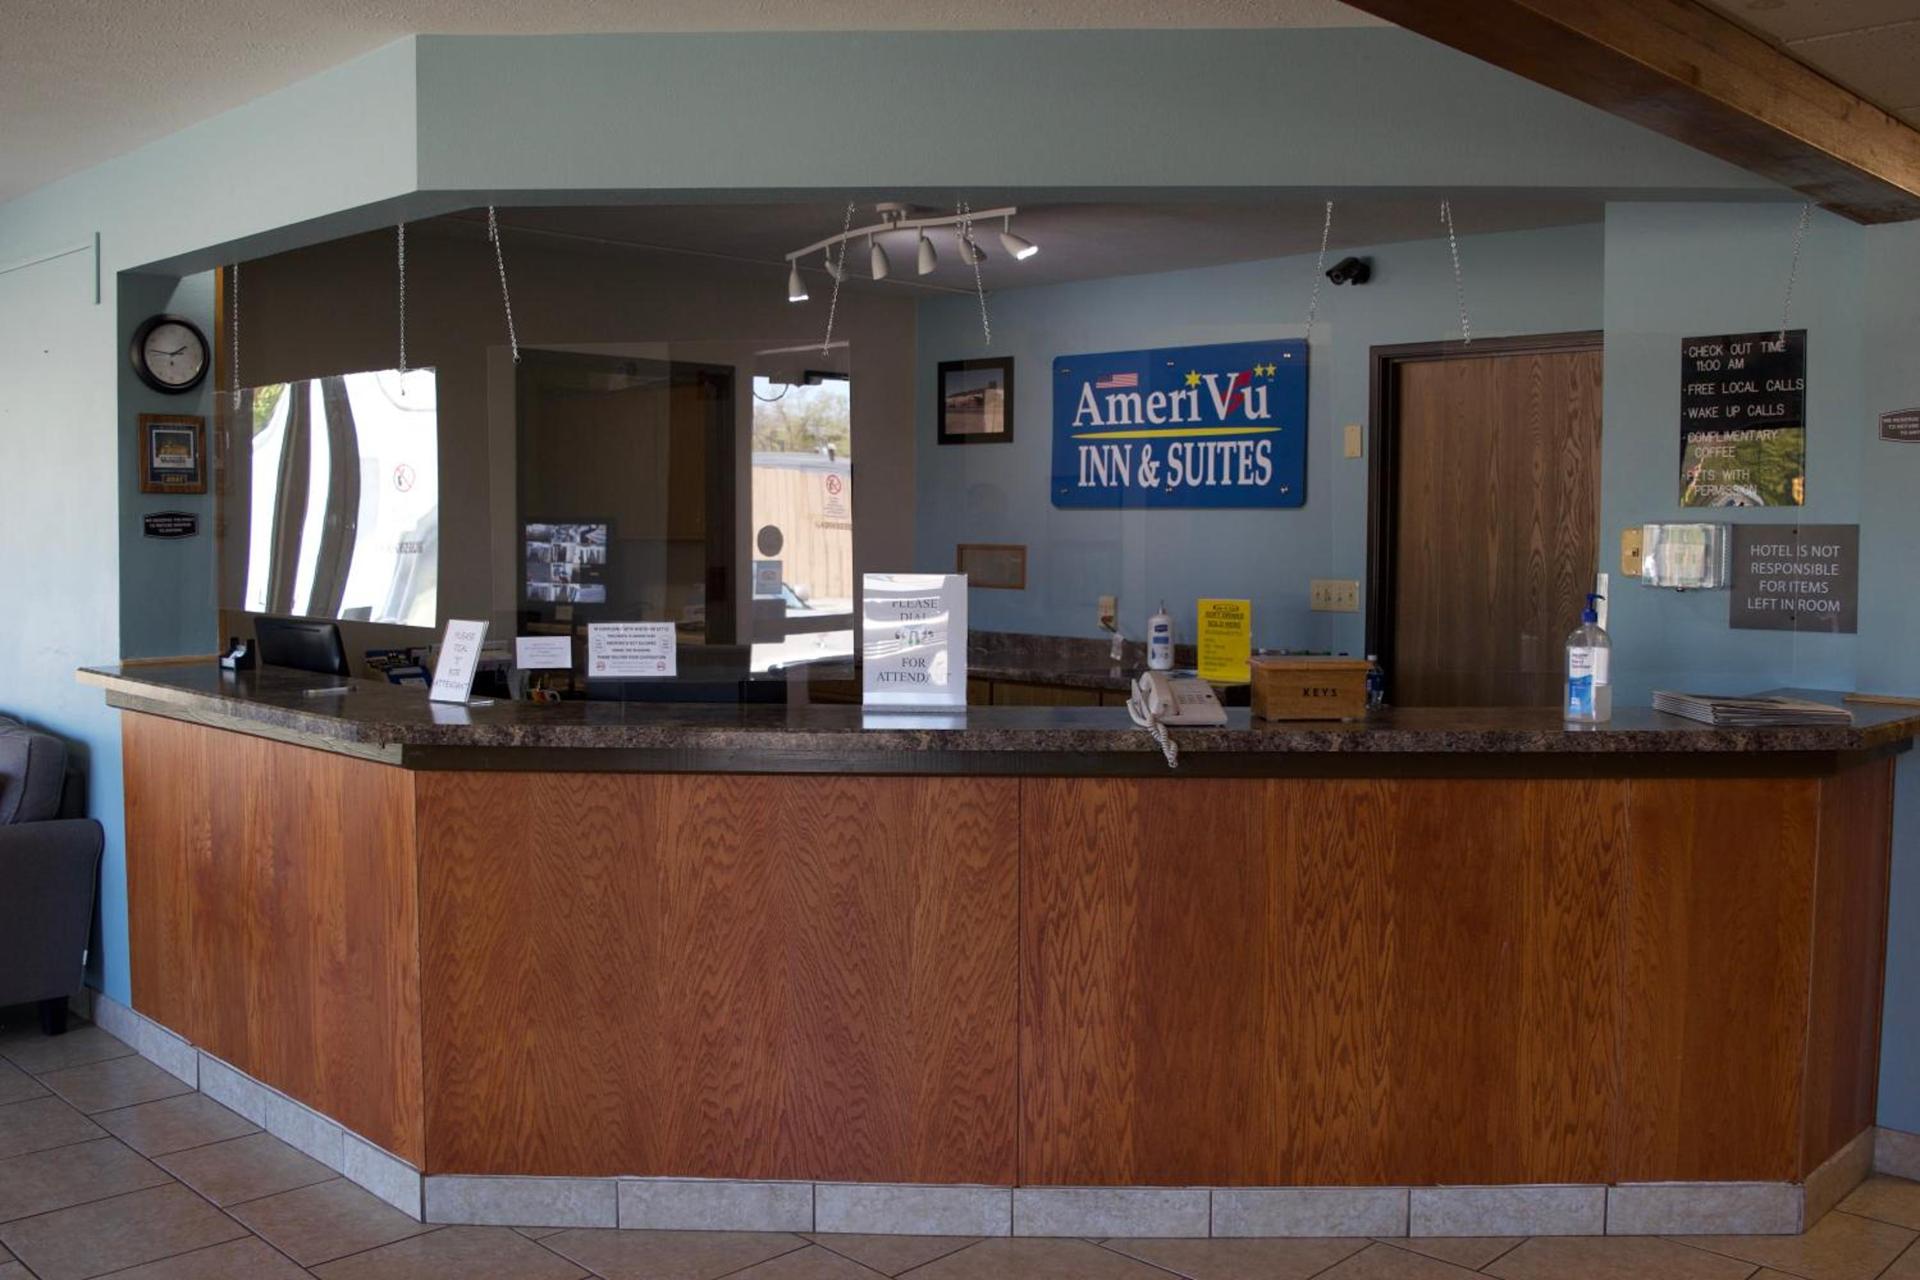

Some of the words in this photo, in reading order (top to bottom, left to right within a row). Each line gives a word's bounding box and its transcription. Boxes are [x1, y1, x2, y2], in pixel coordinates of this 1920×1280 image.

[1689, 345, 1723, 357] CHECK
[1730, 343, 1752, 355] OUT
[1761, 341, 1787, 353] TIME
[1728, 359, 1745, 370] AM
[1688, 383, 1715, 395] FREE
[1722, 381, 1760, 394] LOCAL
[1766, 378, 1805, 391] CALLS
[1072, 372, 1272, 427] AmeriVu
[1688, 406, 1719, 418] WAKE
[1726, 405, 1741, 417] UP
[1747, 403, 1785, 416] CALLS
[1687, 430, 1778, 443] COMPLIMENTARY
[1695, 446, 1736, 458] COFFEE
[1078, 445, 1132, 488] INN
[1138, 444, 1161, 488] &
[1167, 440, 1272, 487] SUITES
[1722, 469, 1750, 480] WITH
[1750, 545, 1792, 557] HOTEL
[1796, 545, 1808, 557] IS
[1811, 545, 1840, 557] NOT
[1751, 563, 1840, 576] RESPONSIBLE
[1760, 580, 1786, 592] FOR
[1789, 581, 1829, 594] ITEMS
[892, 599, 938, 608] PLEASE
[1747, 597, 1779, 609] LEFT
[1781, 598, 1794, 610] IN
[1798, 599, 1840, 612] ROOM
[902, 658, 926, 668] FOR
[877, 672, 951, 683] ATTENDA
[1303, 688, 1338, 697] KEYS
